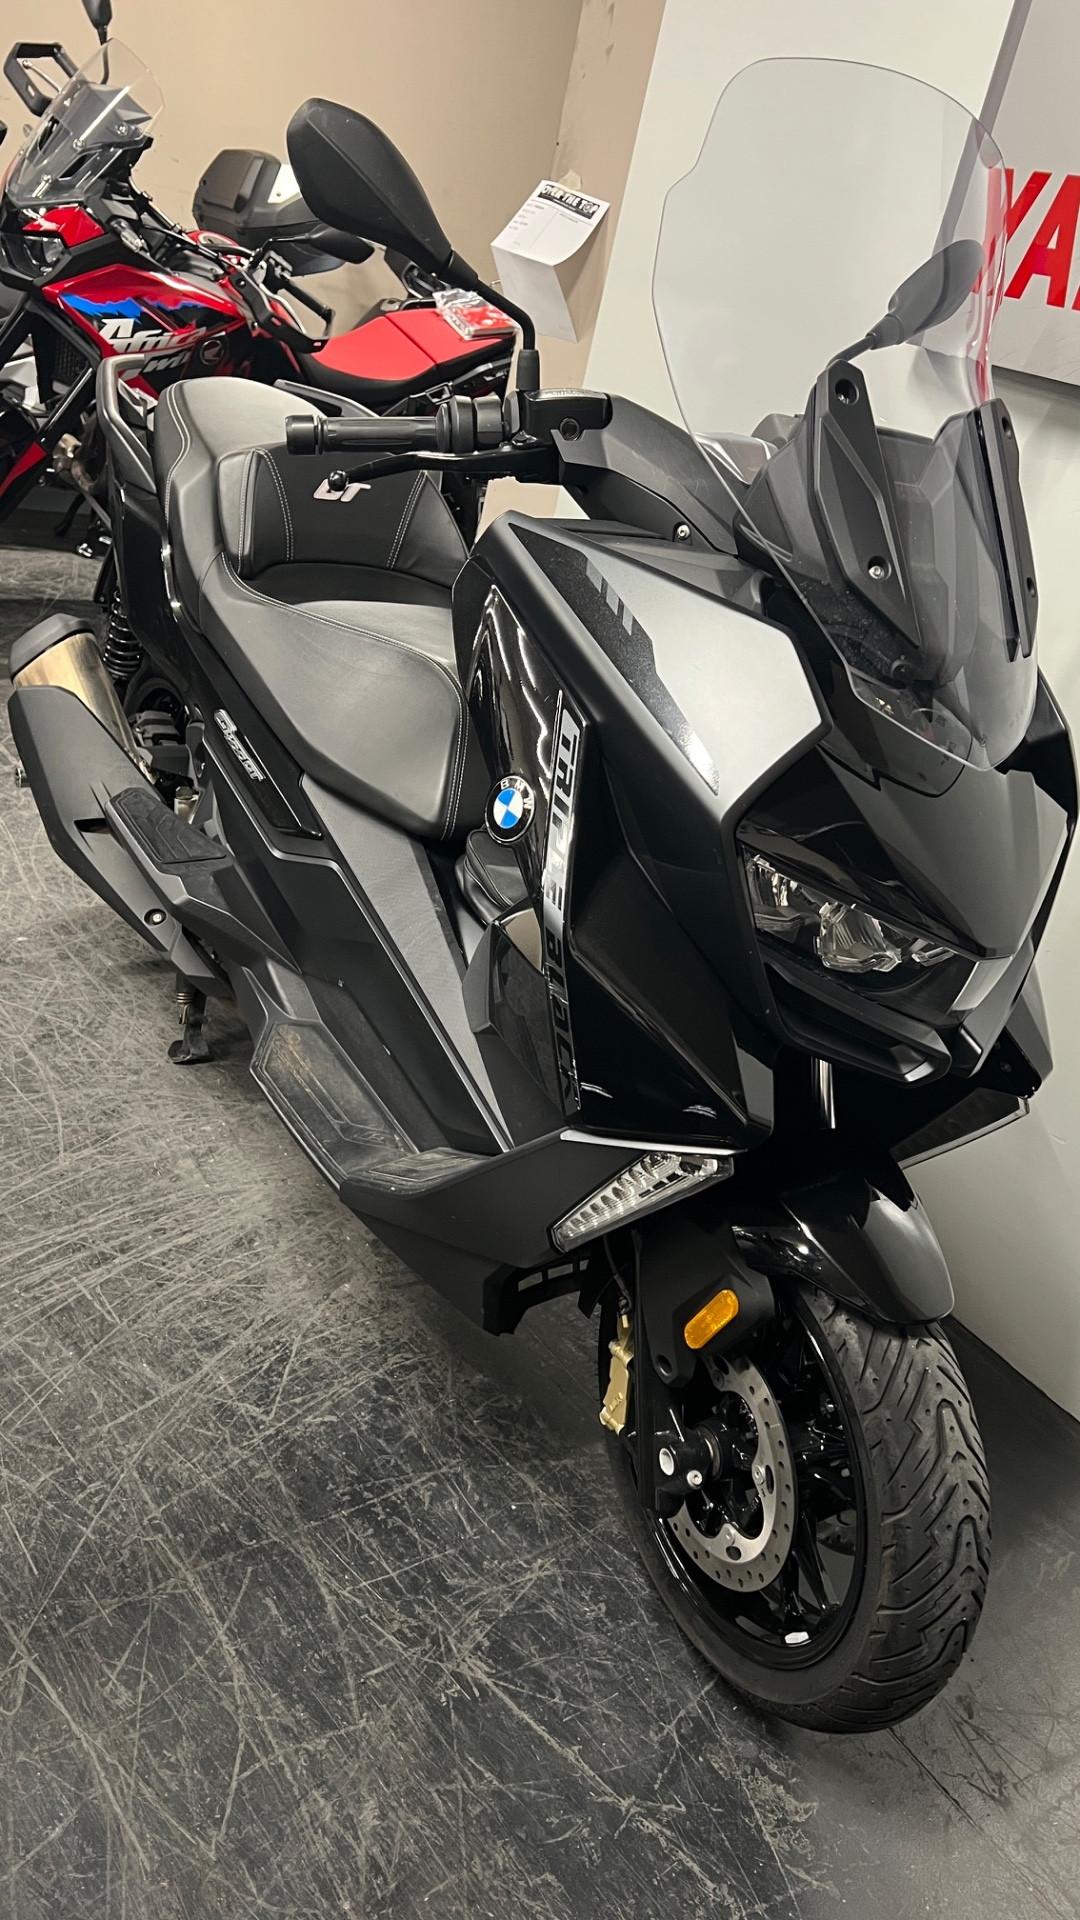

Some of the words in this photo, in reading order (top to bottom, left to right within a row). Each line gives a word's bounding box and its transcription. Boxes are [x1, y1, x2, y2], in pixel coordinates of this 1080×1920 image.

[562, 192, 581, 207] THE
[579, 199, 599, 214] TOP
[984, 167, 1080, 312] YA
[99, 318, 207, 353] Afric
[500, 778, 533, 810] BMW
